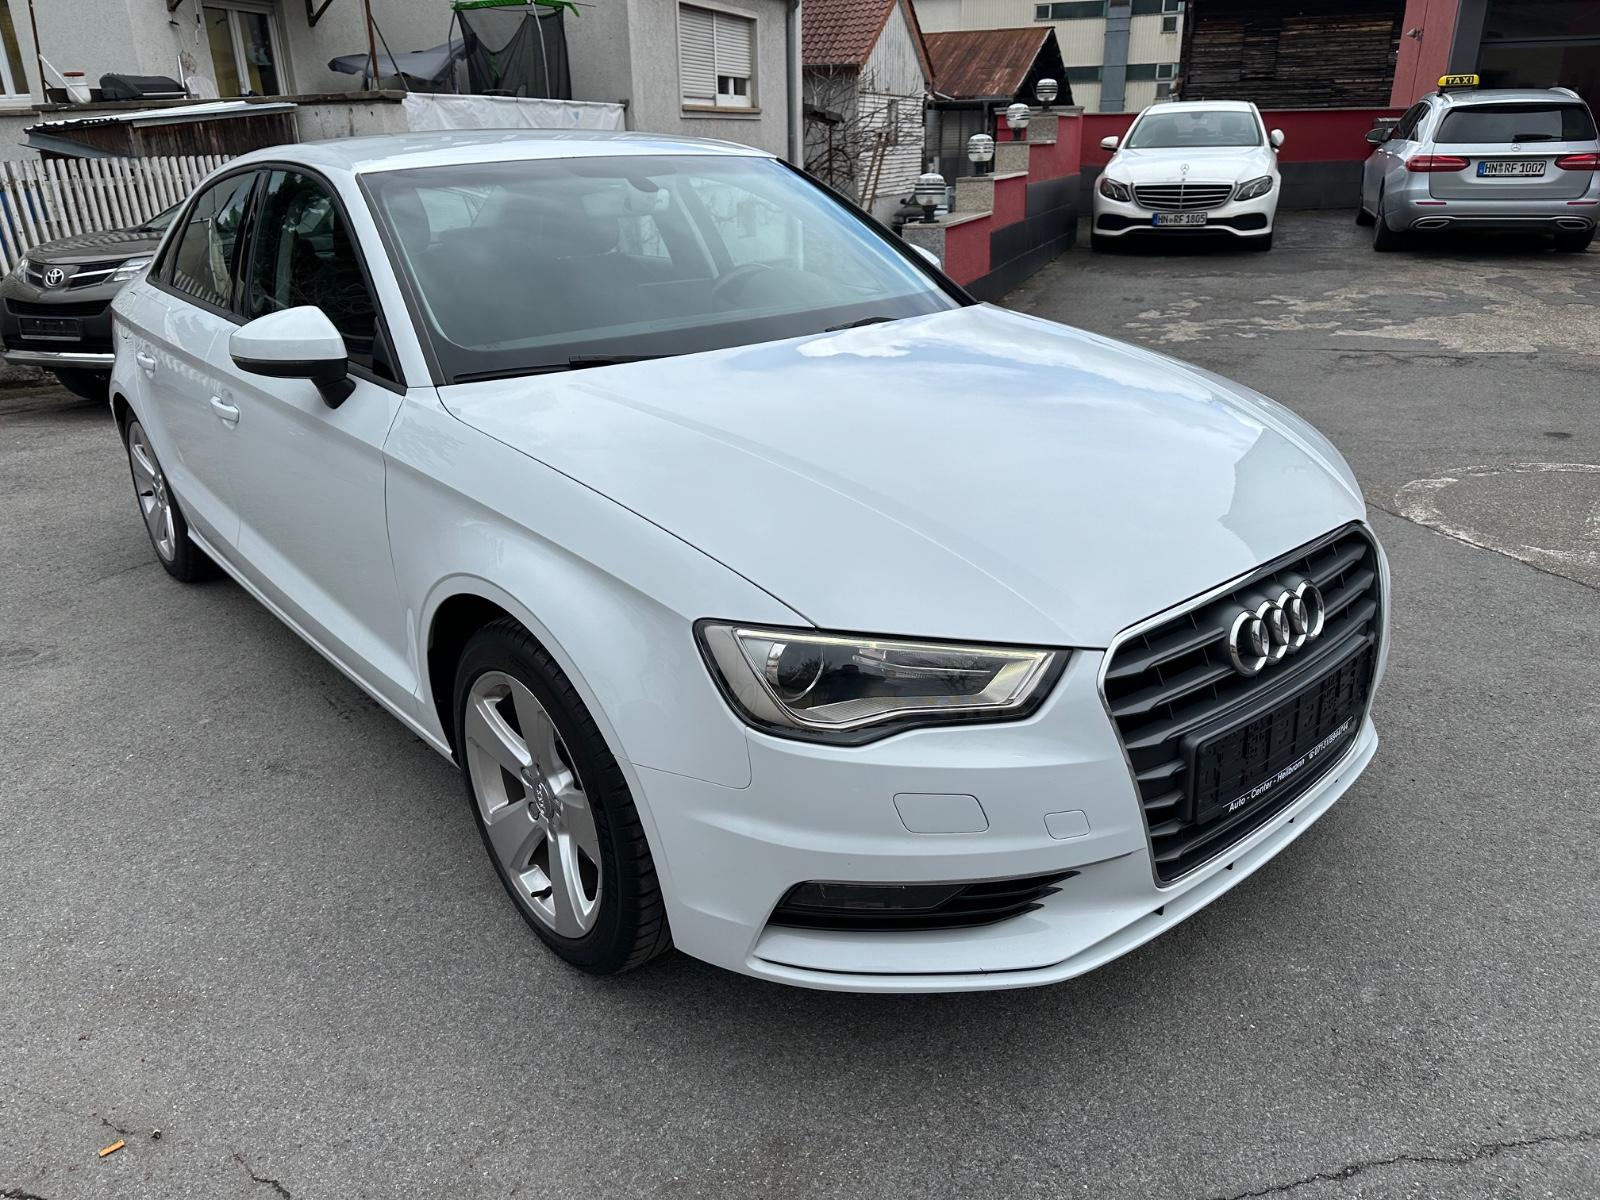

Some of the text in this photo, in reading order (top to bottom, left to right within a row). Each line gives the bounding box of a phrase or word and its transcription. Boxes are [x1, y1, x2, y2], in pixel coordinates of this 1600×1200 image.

[1447, 76, 1473, 84] TAXI
[1484, 162, 1545, 173] HN RF 1007
[1173, 214, 1185, 224] RF
[1186, 214, 1206, 223] 1805
[1229, 797, 1246, 812] Auto
[1250, 780, 1273, 799] Center
[1277, 758, 1305, 783] Heilbronn
